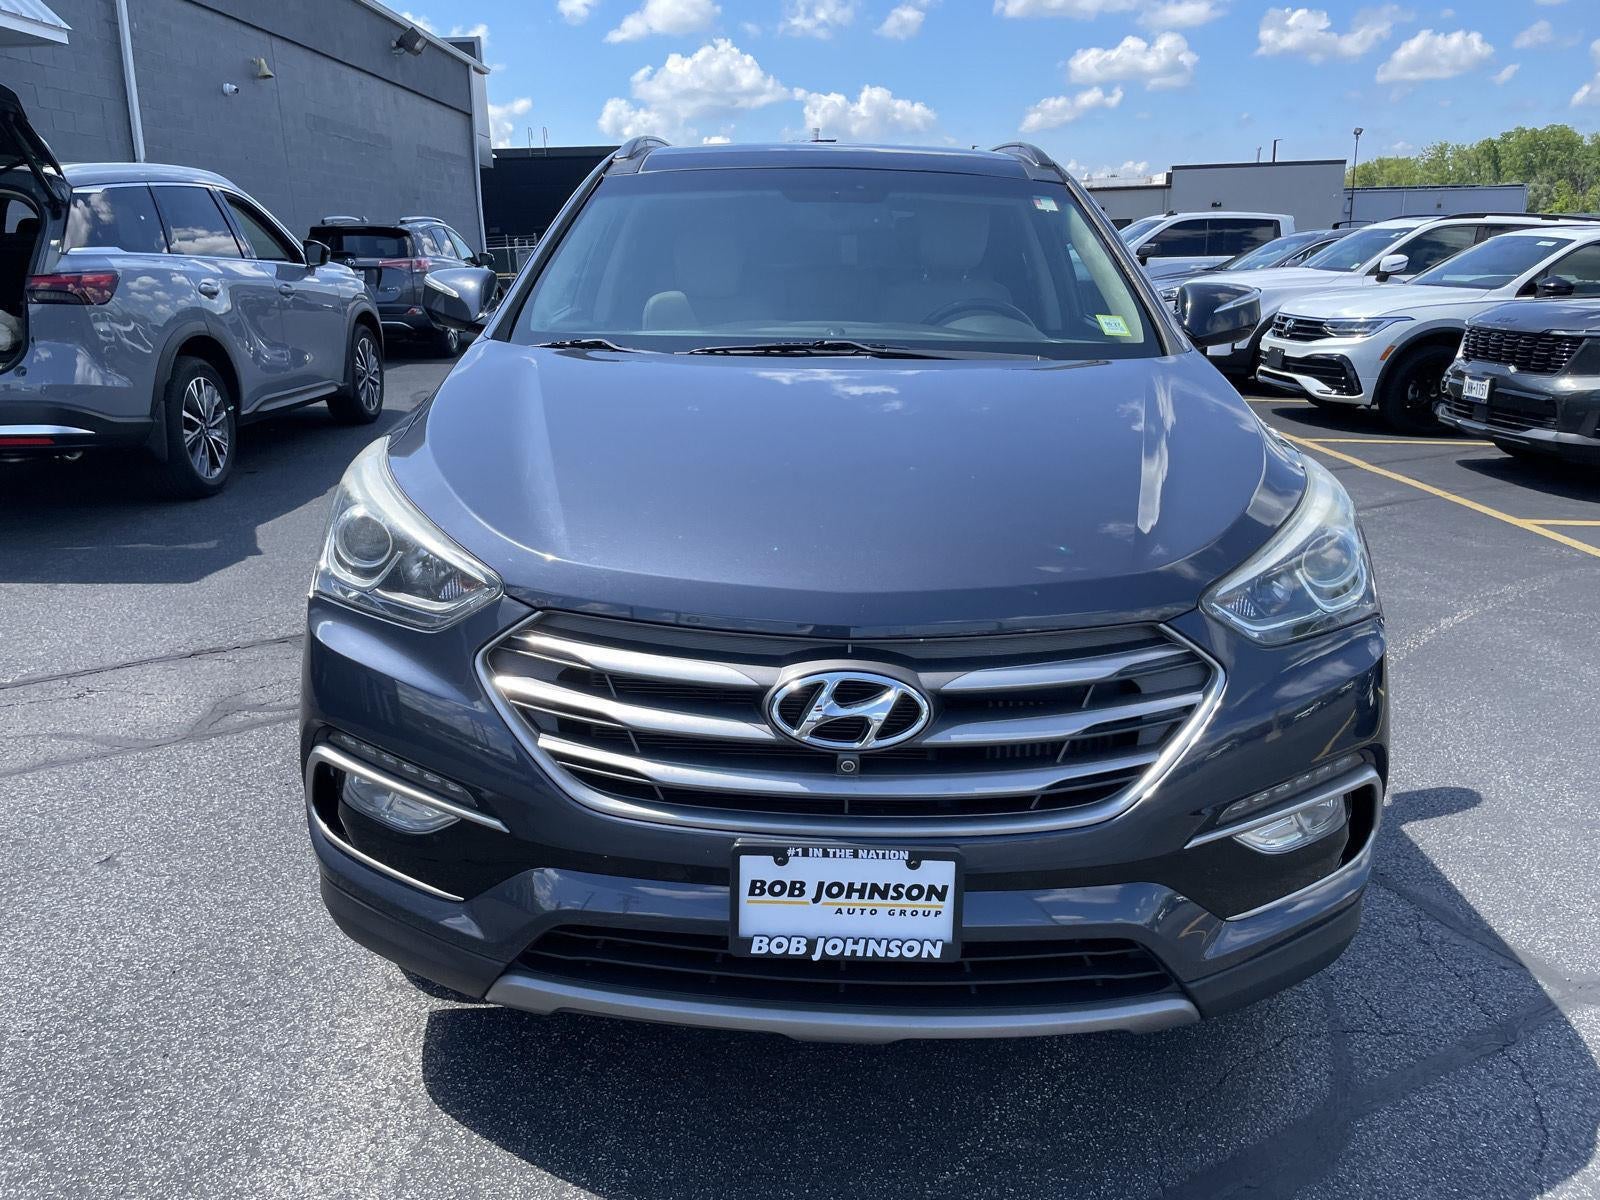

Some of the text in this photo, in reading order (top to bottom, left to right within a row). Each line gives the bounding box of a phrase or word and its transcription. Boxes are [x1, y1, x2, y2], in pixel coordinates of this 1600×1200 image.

[787, 847, 909, 860] #1 IN THE NATION
[748, 879, 948, 904] BOB JOHNSON
[834, 907, 942, 917] AUTO GROUP
[750, 935, 943, 961] BOB JOHNSON
